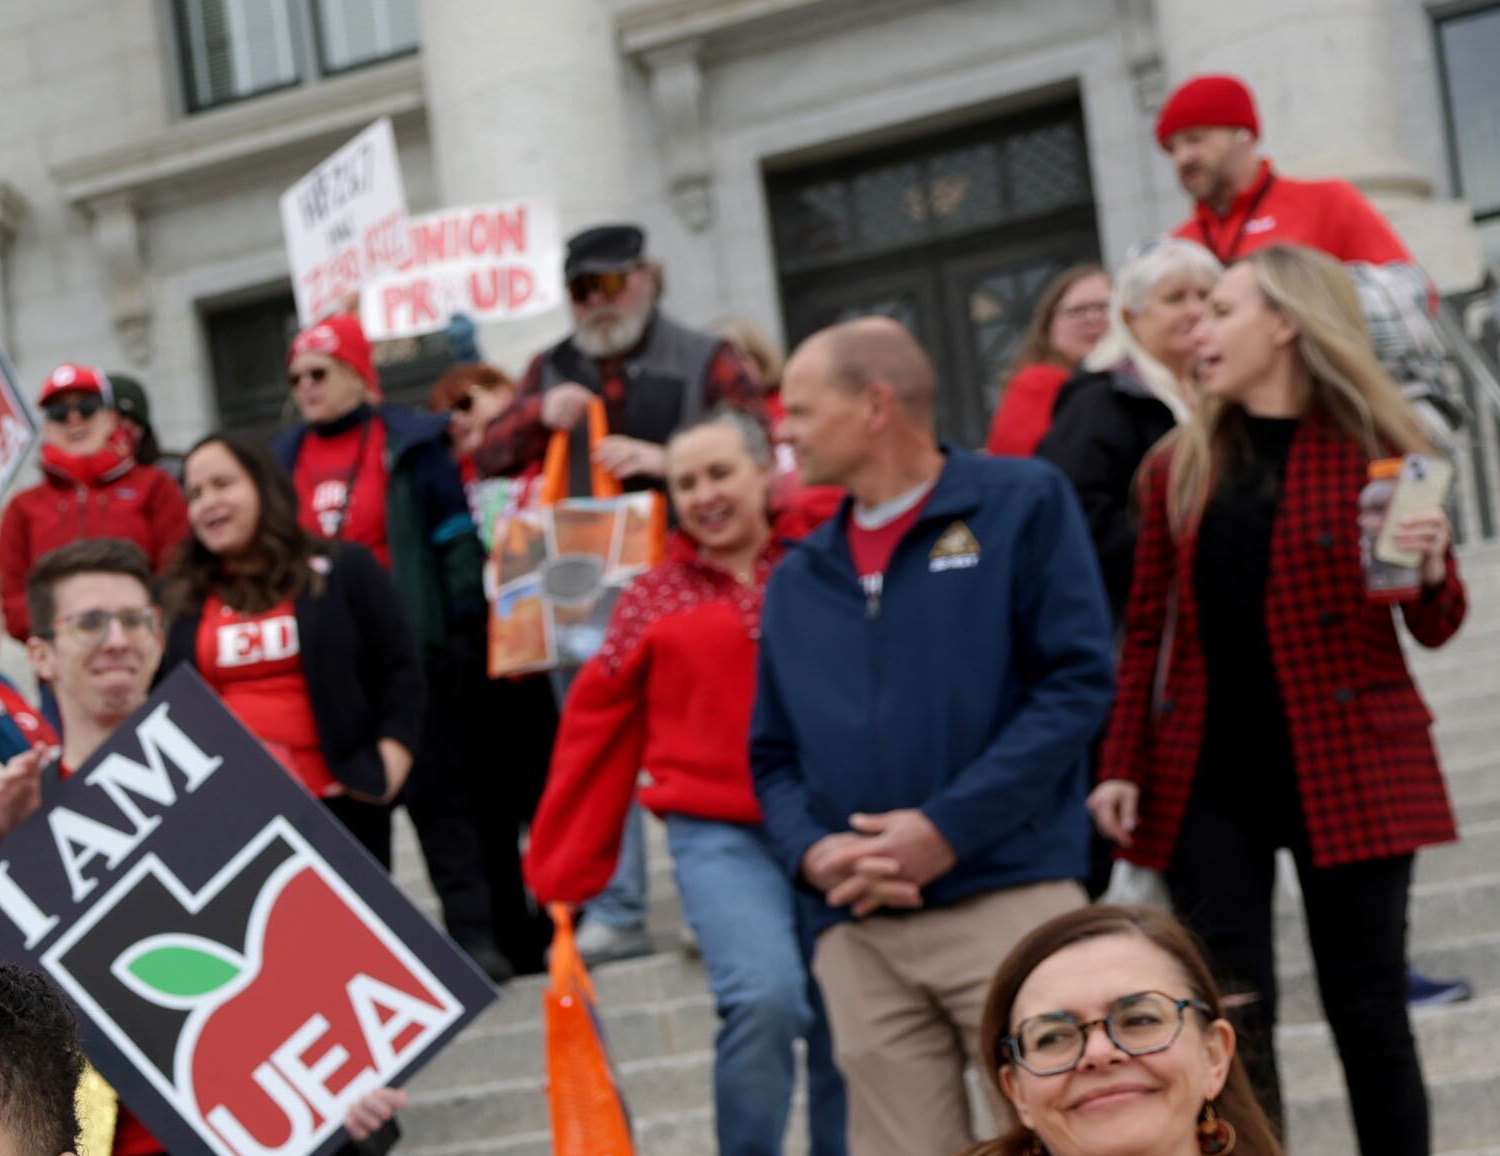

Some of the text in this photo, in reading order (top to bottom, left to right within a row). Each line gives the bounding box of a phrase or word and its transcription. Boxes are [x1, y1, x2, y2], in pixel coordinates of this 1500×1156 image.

[398, 206, 526, 272] UNION
[216, 615, 300, 668] ED
[48, 702, 224, 903] AM
